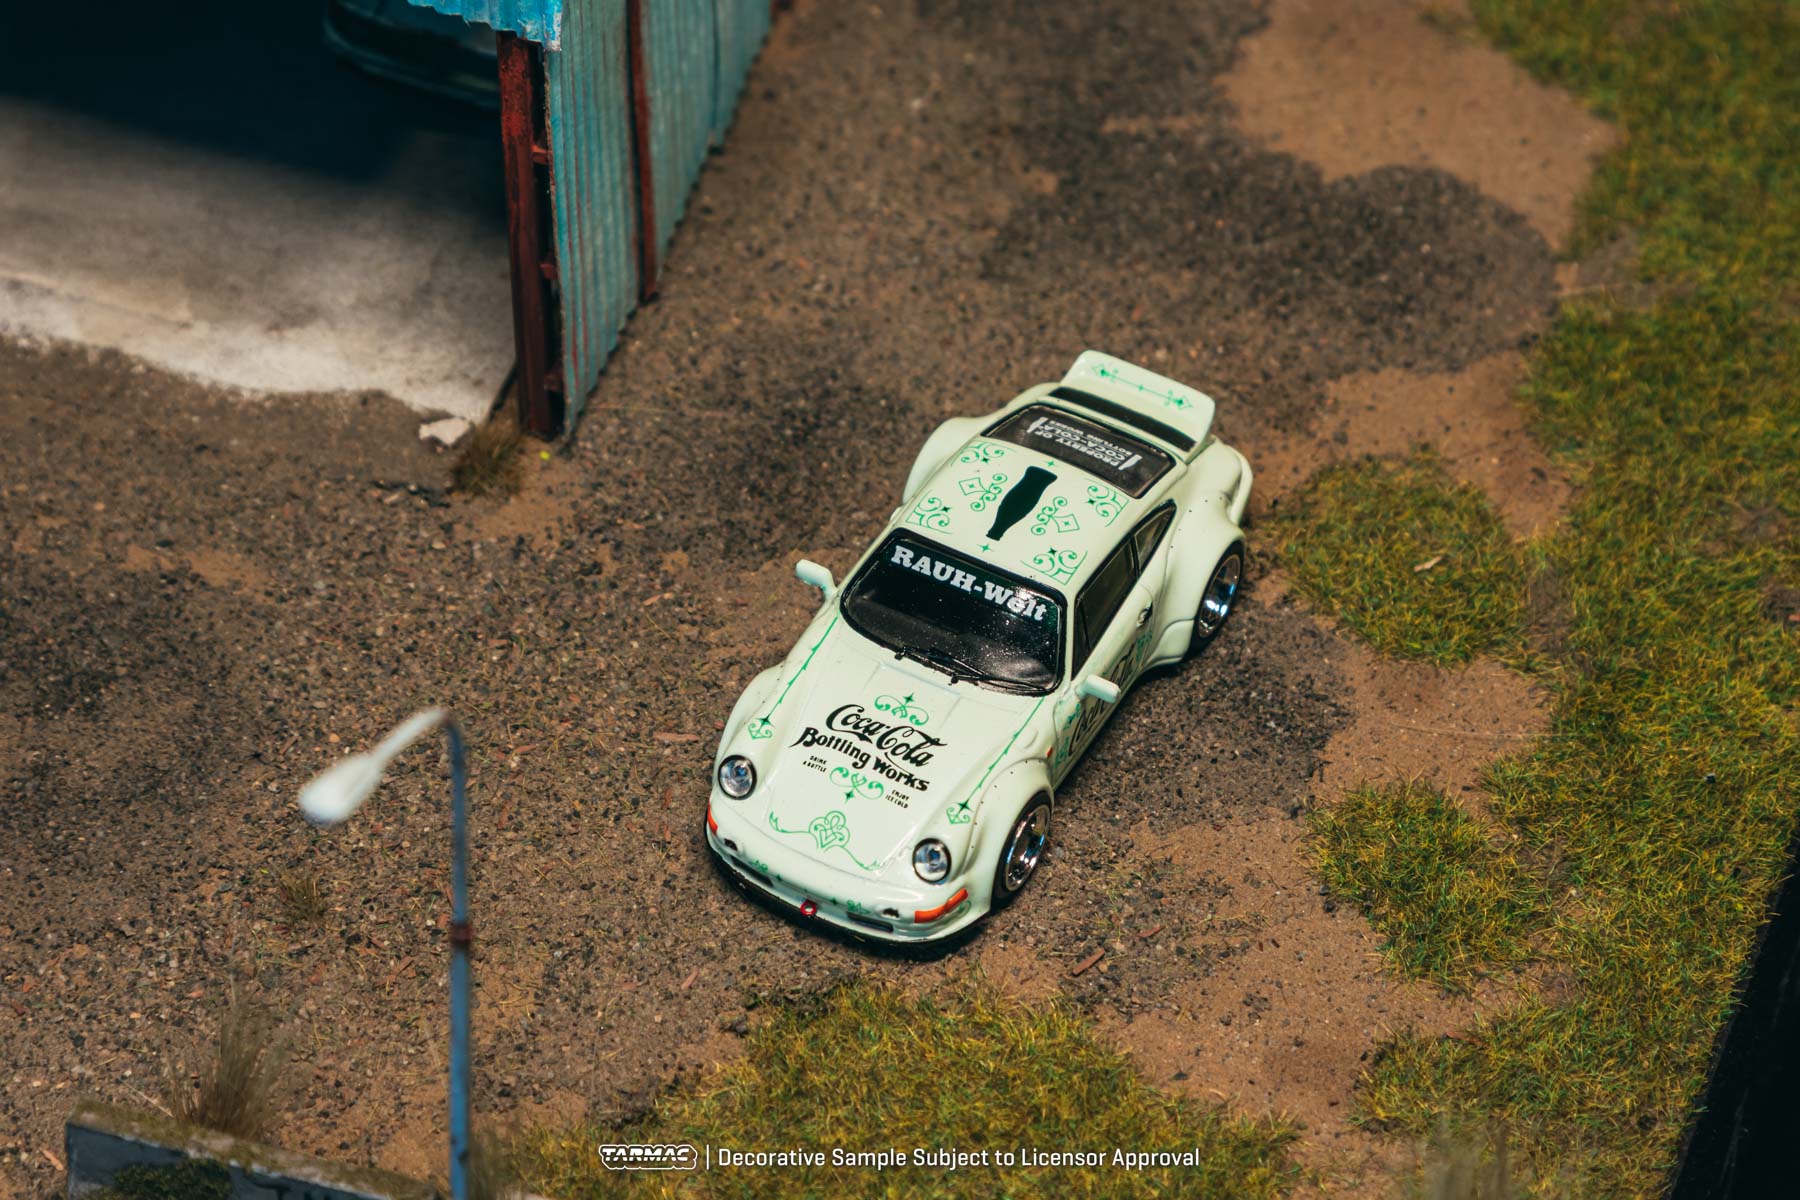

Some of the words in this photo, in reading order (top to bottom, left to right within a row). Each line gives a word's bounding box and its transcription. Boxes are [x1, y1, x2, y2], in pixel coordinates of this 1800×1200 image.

[1035, 430, 1052, 438] OF
[1056, 438, 1120, 467] PROPERTY
[891, 545, 1047, 621] RAUH-Welt
[788, 727, 871, 769] Bottling
[826, 704, 948, 767] Coca-Cola
